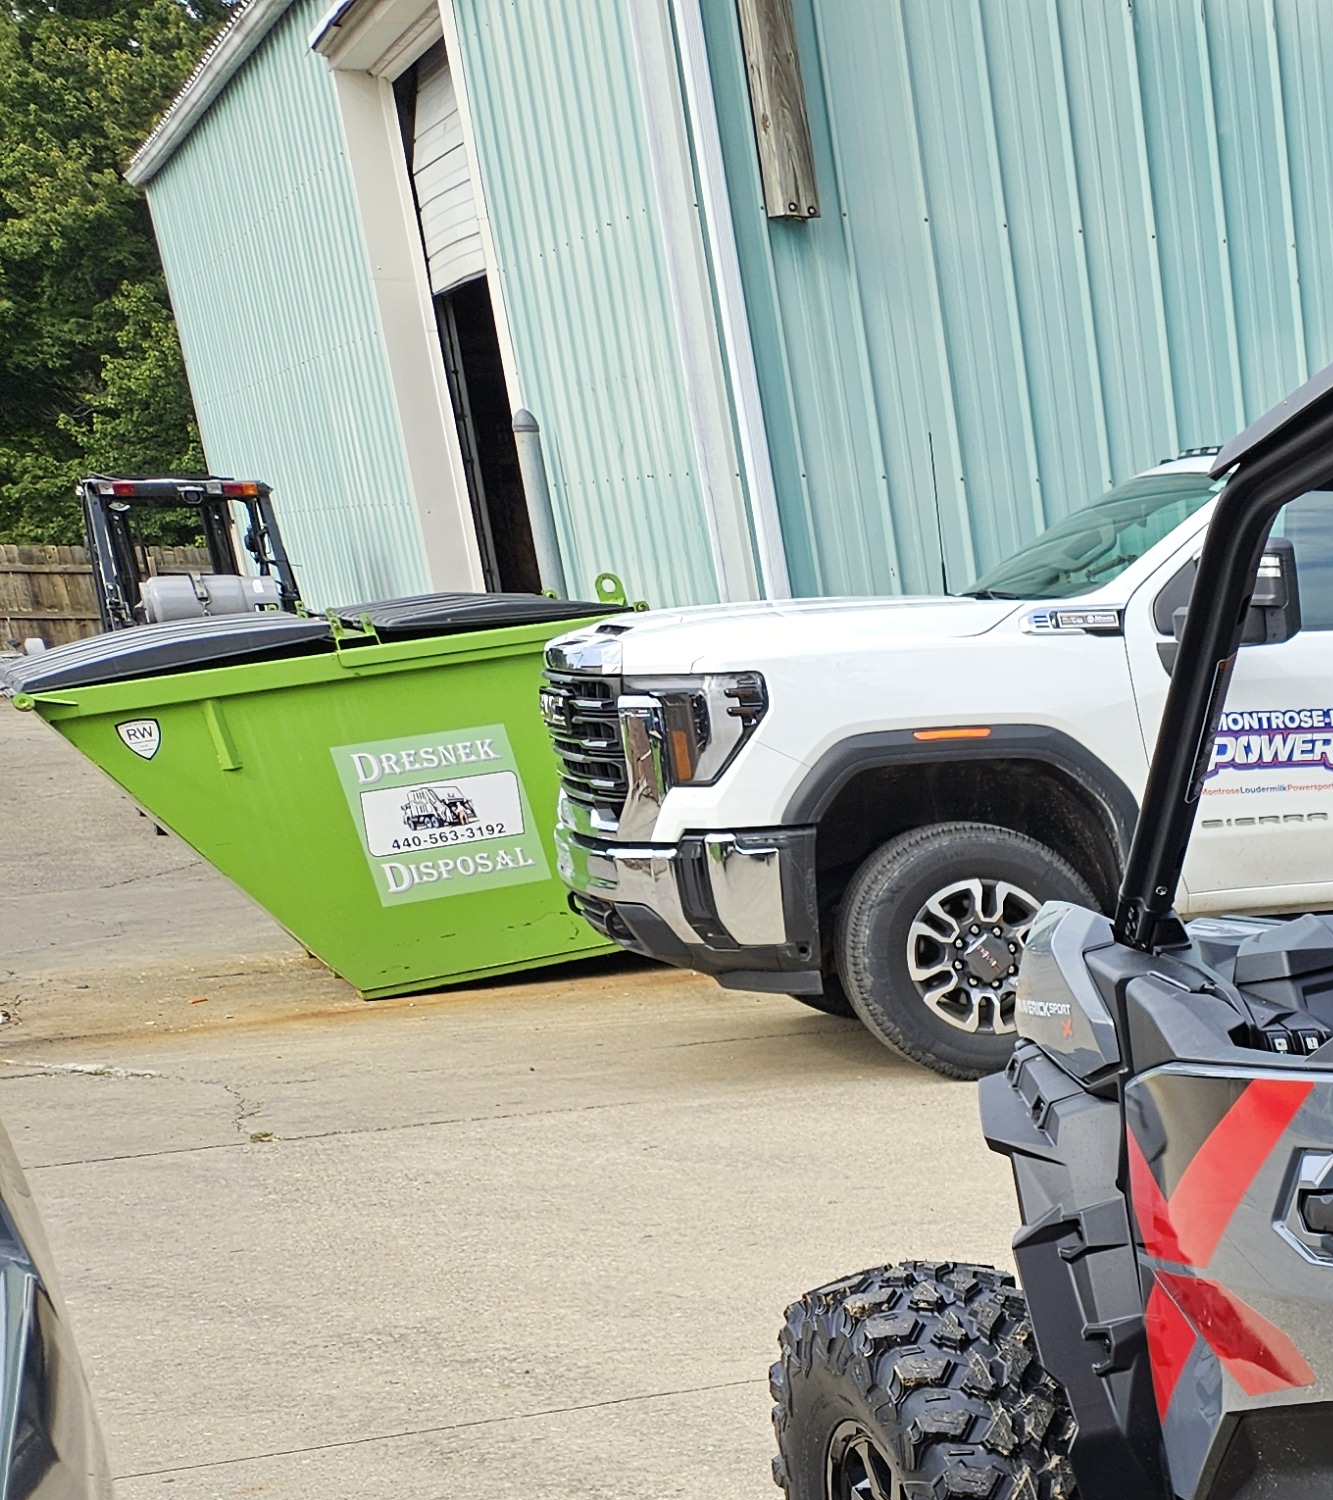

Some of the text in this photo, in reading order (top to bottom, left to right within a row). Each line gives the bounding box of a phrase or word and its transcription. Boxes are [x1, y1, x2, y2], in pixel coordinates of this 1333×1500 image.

[126, 725, 153, 741] RW
[1201, 812, 1329, 829] SIERRA
[391, 822, 507, 850] 440-563-3192
